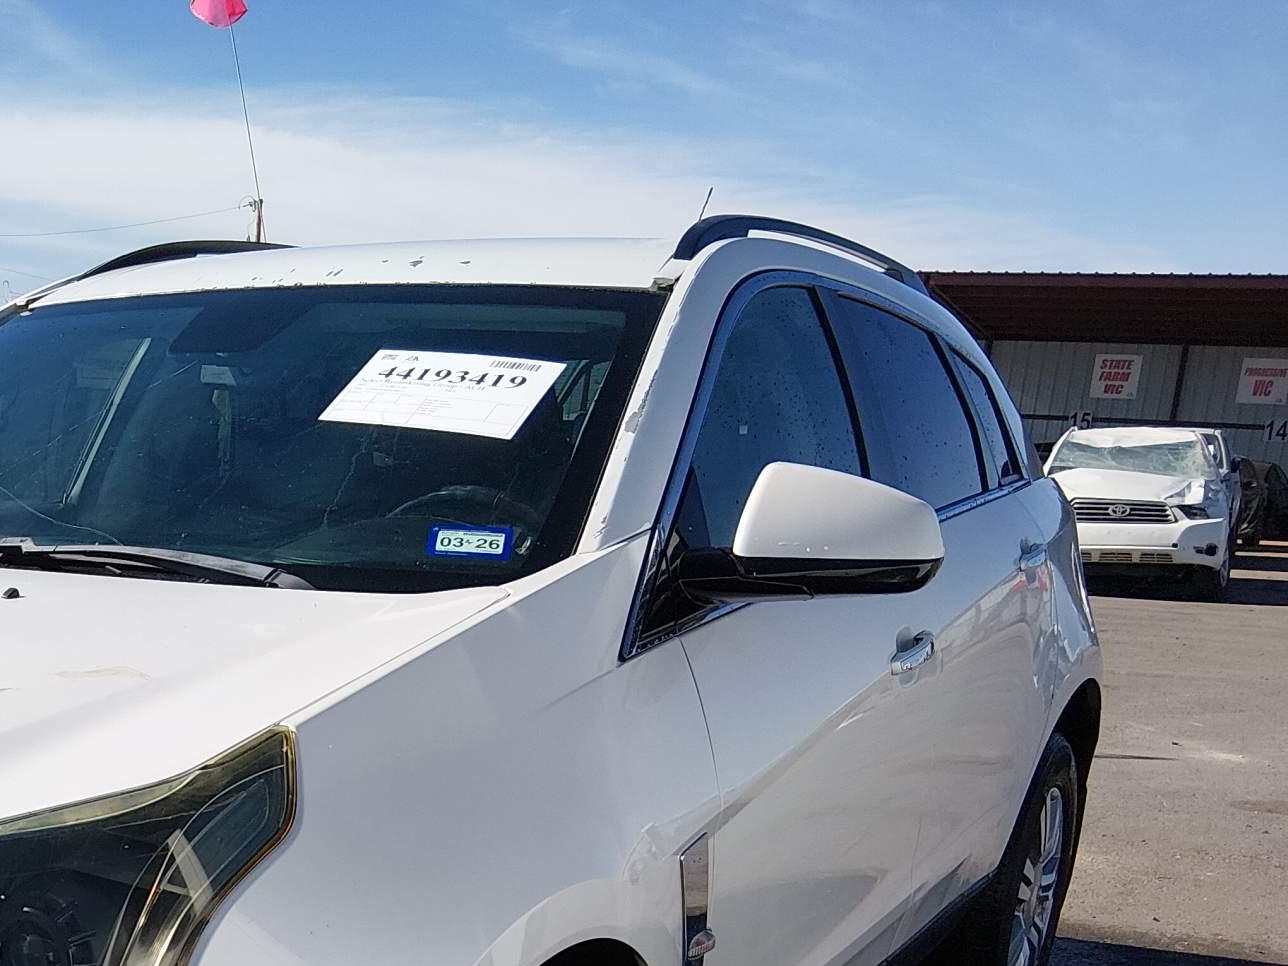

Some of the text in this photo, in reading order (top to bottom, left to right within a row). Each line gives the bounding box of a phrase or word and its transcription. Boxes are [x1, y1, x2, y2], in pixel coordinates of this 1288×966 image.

[1100, 359, 1135, 370] STATE
[378, 366, 527, 389] 44193419
[1099, 371, 1132, 382] FARM
[1252, 380, 1274, 397] VIC
[1070, 411, 1092, 430] 15
[1266, 420, 1288, 441] 14
[439, 536, 500, 550] 03 26
